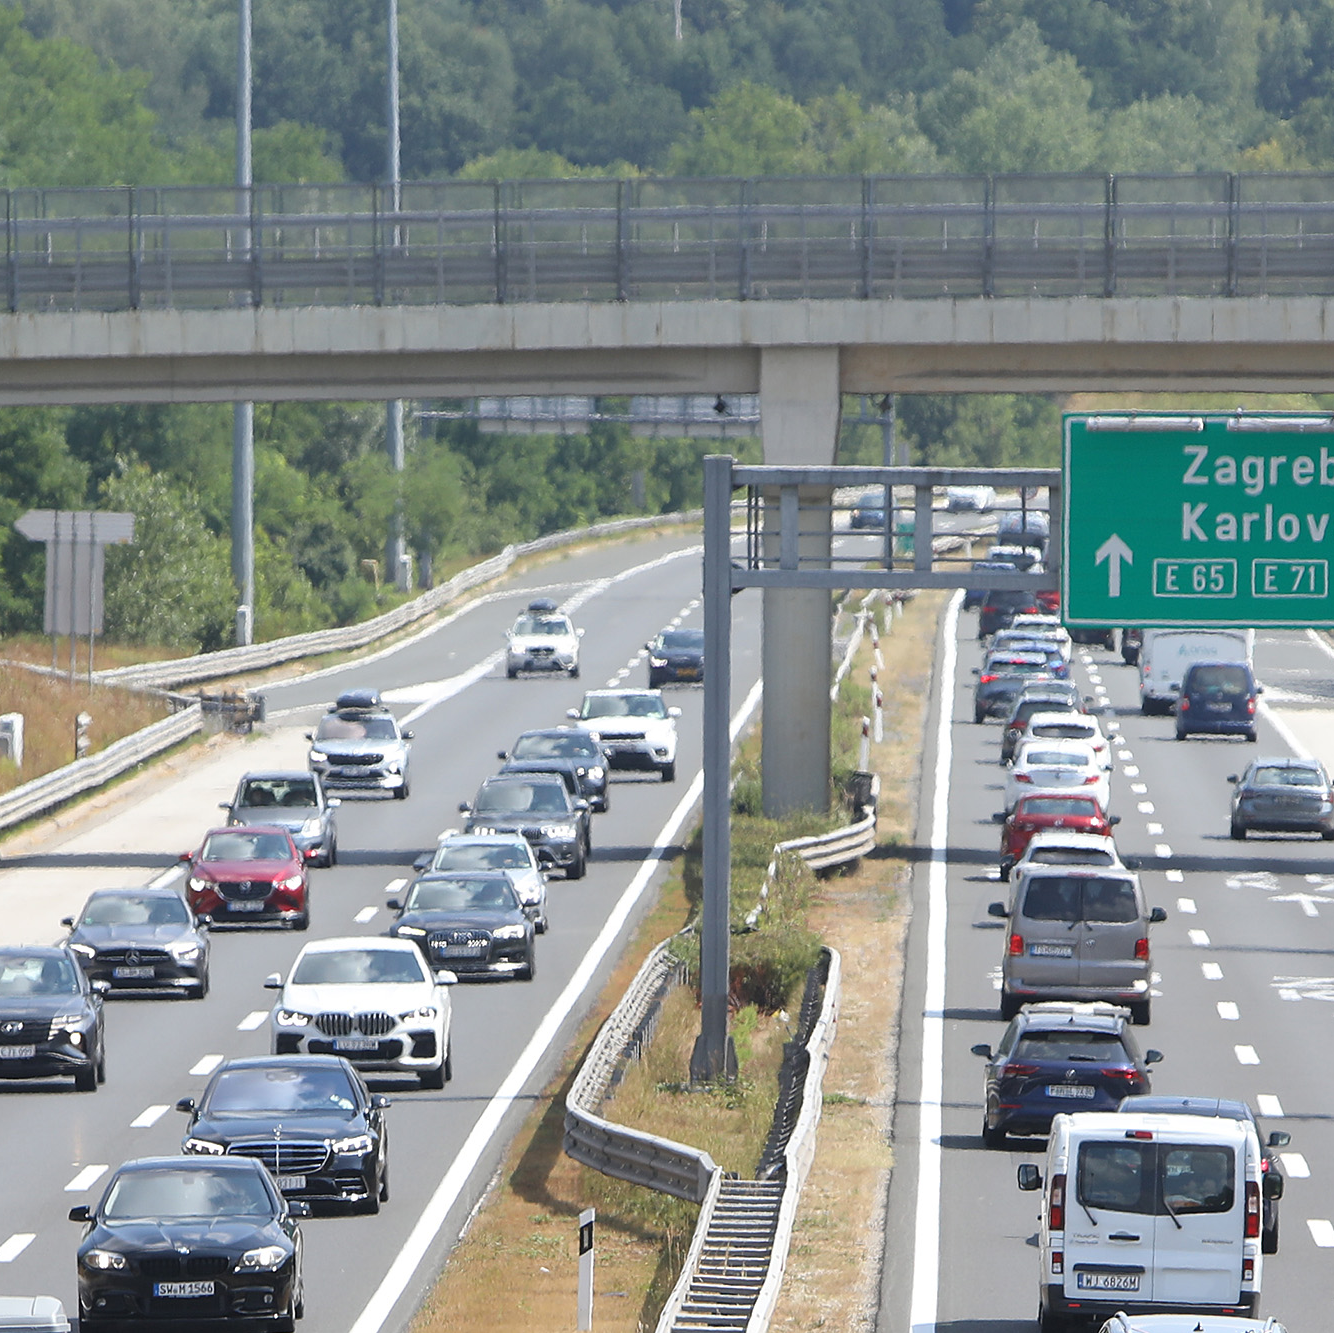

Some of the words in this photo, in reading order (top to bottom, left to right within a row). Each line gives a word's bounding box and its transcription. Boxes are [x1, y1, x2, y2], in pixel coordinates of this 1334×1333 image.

[1167, 566, 1179, 591] E
[1192, 566, 1225, 591] 65
[1266, 566, 1278, 591] E
[1290, 567, 1317, 591] 71
